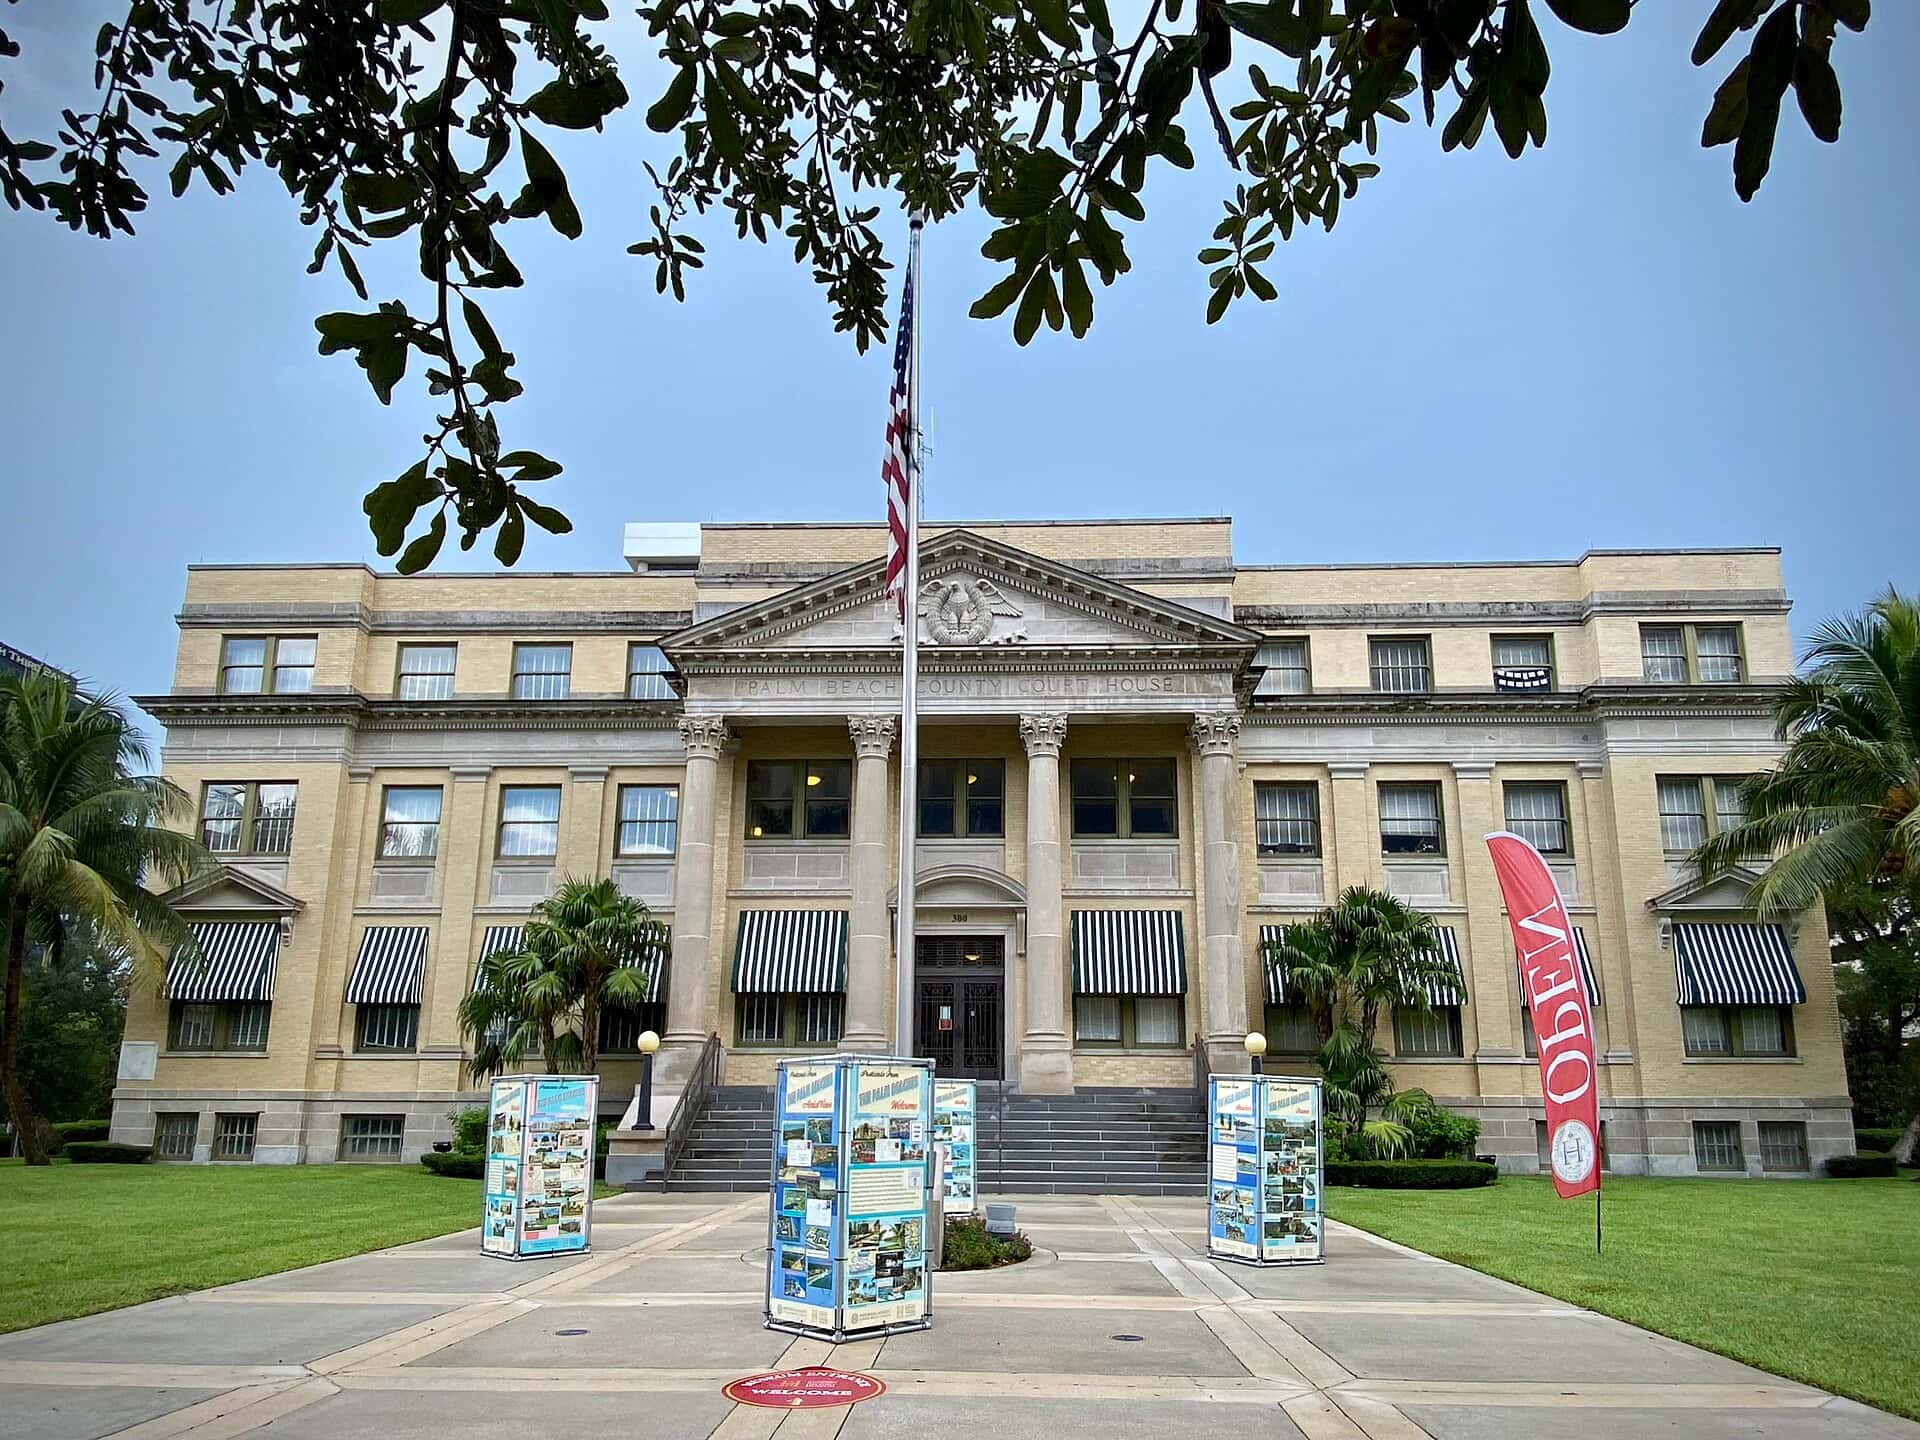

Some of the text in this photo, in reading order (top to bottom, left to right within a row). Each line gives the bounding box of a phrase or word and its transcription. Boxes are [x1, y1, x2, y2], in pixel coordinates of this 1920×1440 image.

[749, 678, 1173, 694] PALM BEACH COUNTY COURT HOUSE
[1517, 895, 1591, 1104] OPEN
[751, 1388, 852, 1397] WELCOME
